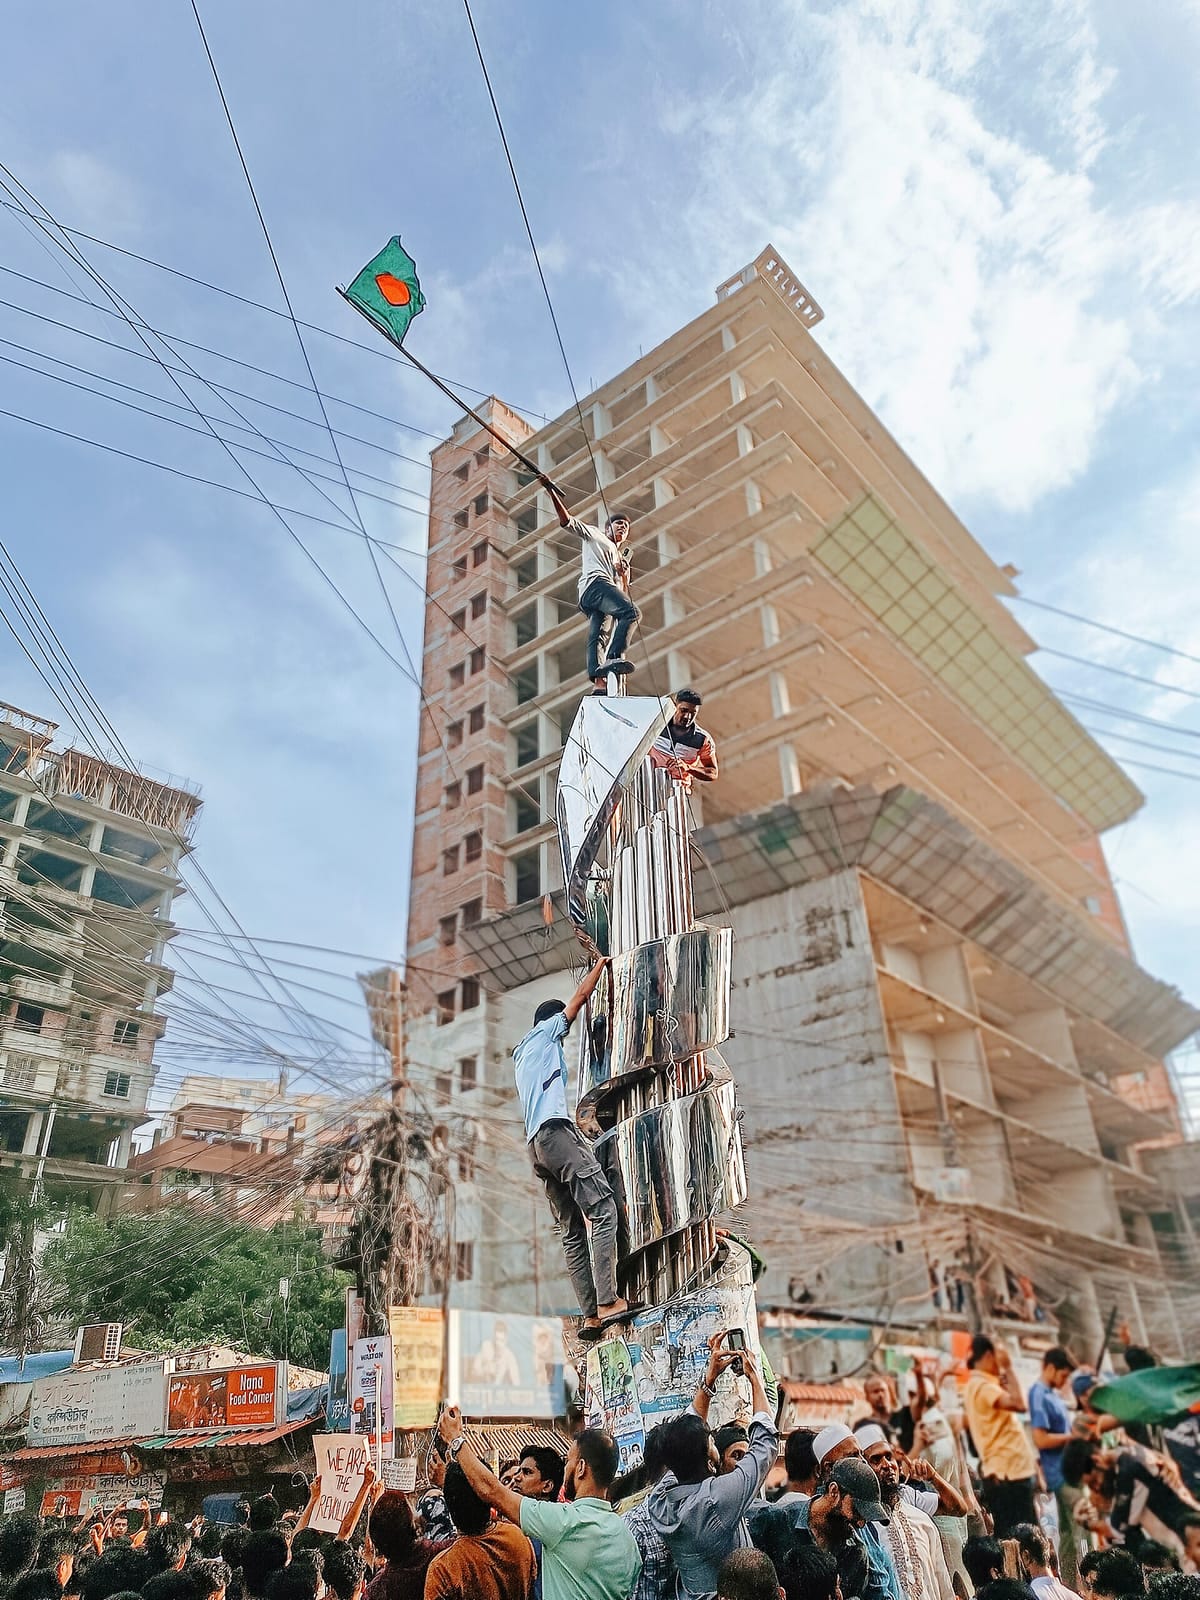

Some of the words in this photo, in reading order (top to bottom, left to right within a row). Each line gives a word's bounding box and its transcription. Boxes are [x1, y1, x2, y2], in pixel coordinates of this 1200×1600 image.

[229, 1392, 247, 1406] Food
[248, 1391, 274, 1405] Corner
[327, 1447, 346, 1471] WE
[345, 1447, 367, 1475] ARE
[336, 1474, 352, 1493] THE
